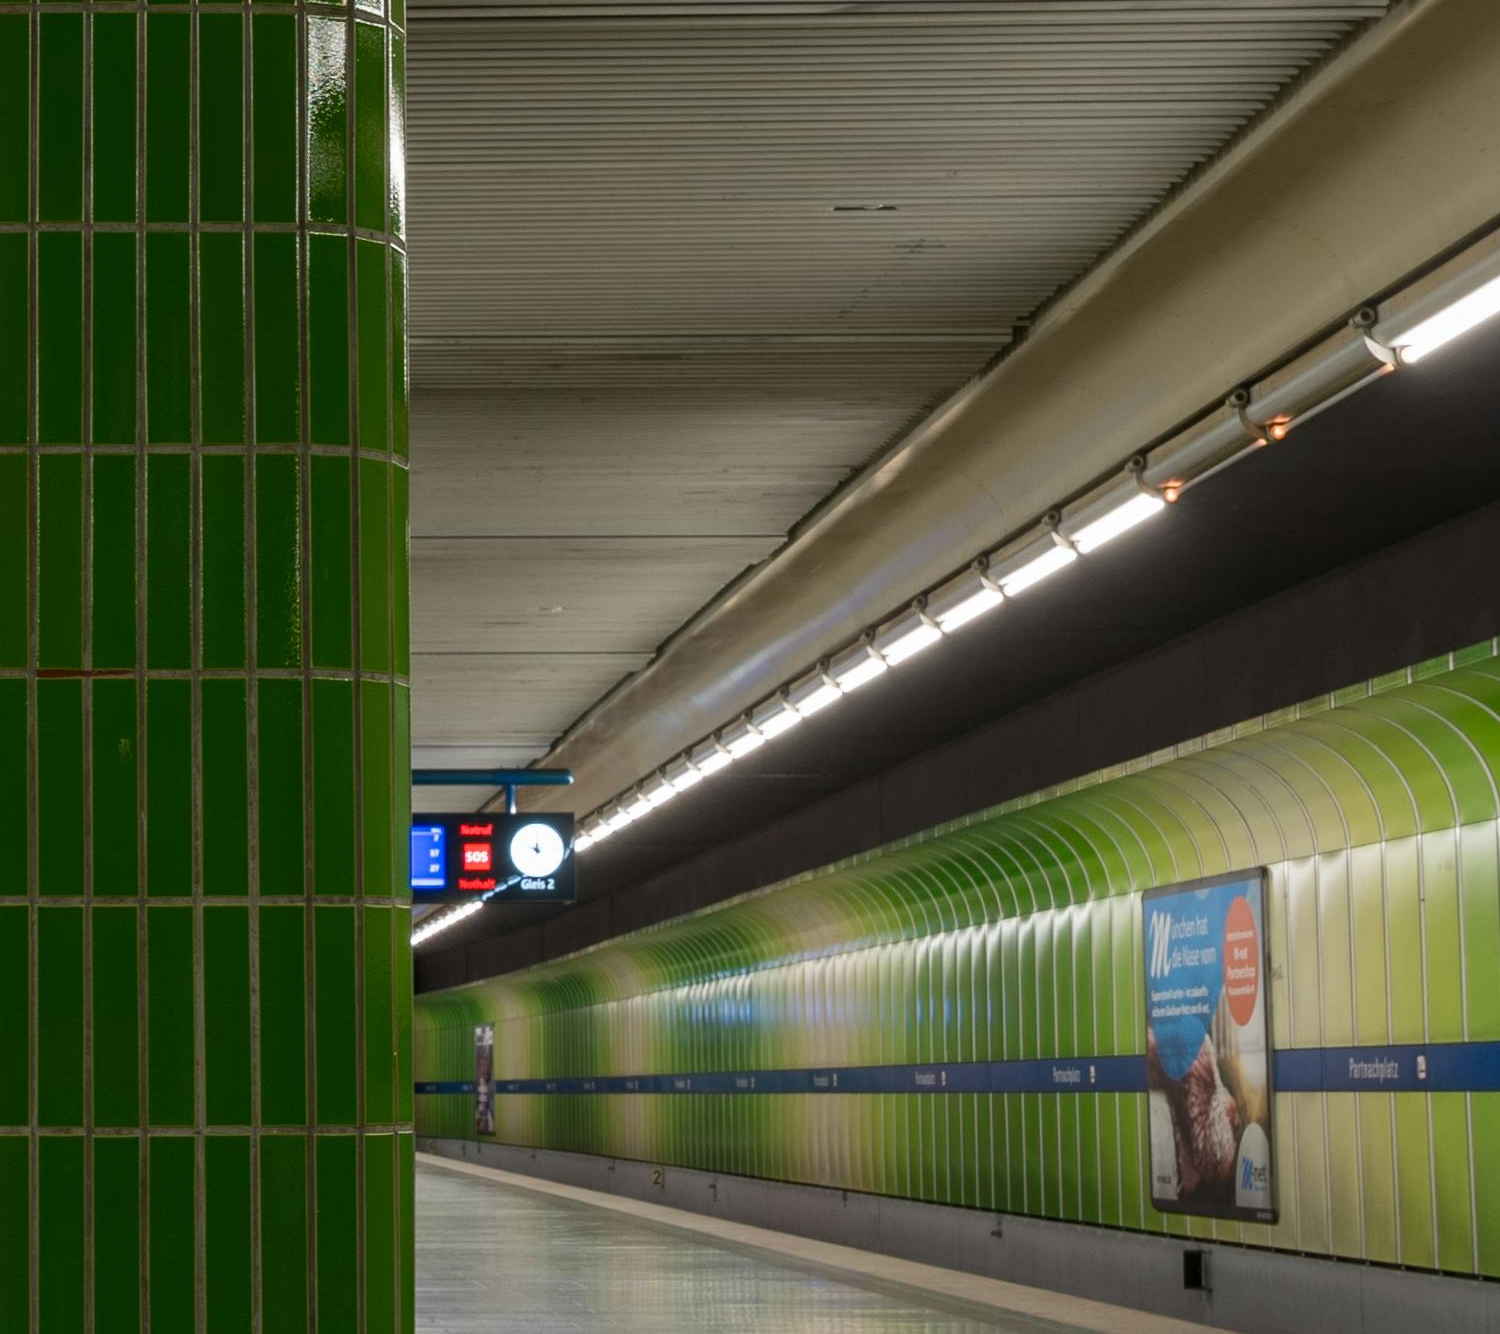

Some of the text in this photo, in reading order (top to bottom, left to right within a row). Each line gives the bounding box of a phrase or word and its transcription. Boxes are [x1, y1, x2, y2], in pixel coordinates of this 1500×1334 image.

[465, 851, 489, 863] SOS
[547, 878, 555, 890] 2
[652, 1169, 662, 1186] 2
